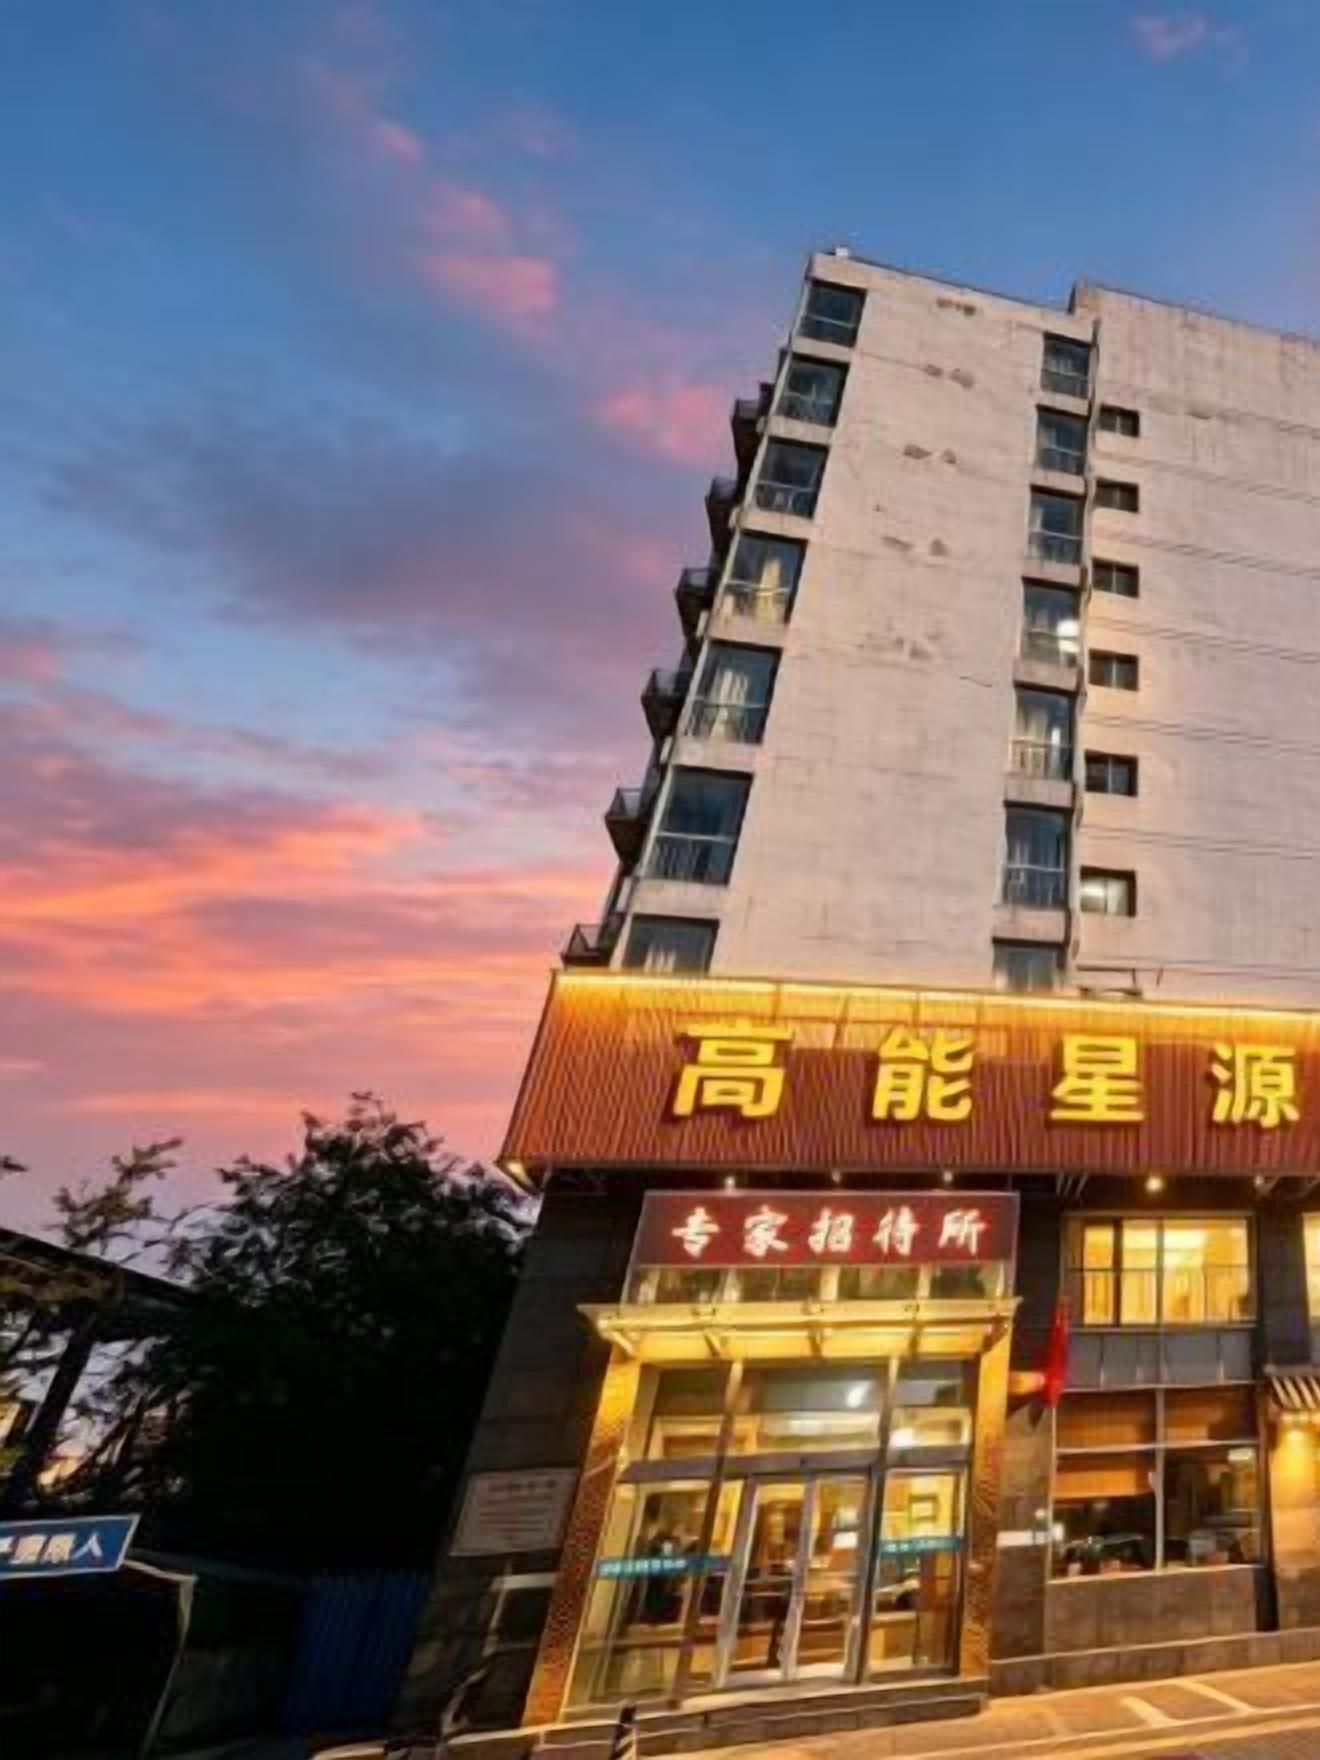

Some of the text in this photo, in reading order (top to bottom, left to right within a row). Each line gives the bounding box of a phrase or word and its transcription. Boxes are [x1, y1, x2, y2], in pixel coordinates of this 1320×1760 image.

[671, 1204, 987, 1257] 专家招待所
